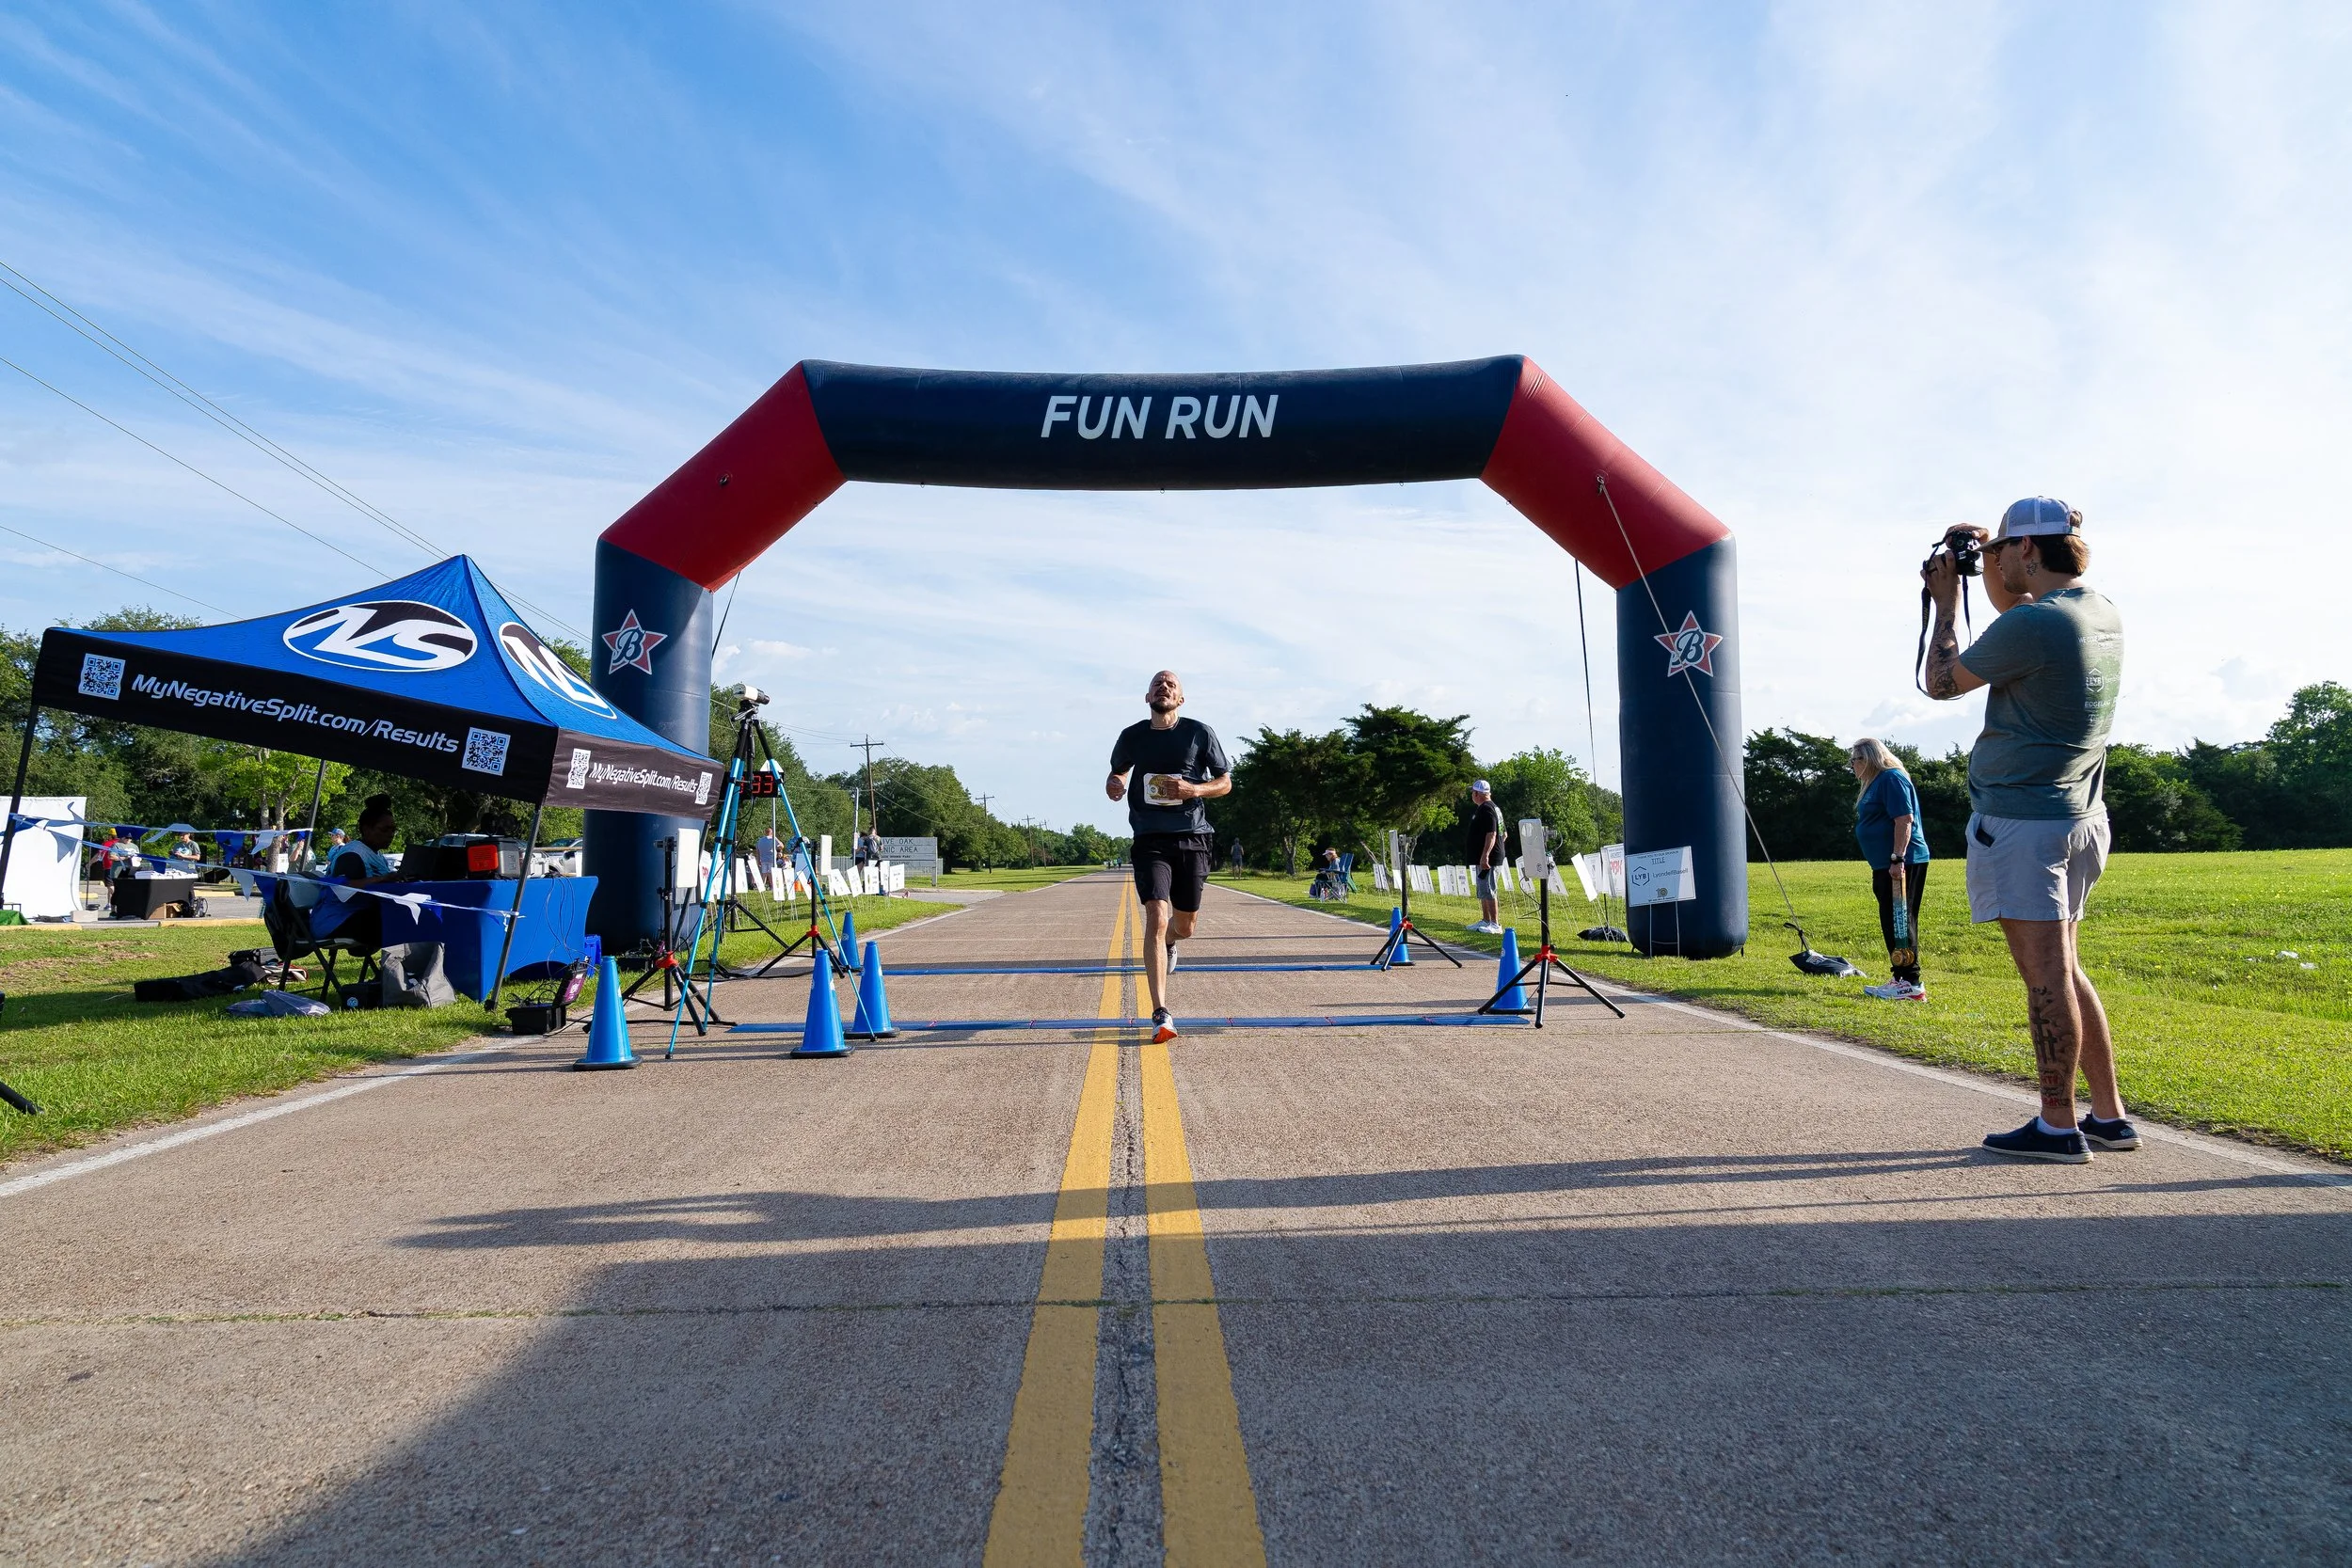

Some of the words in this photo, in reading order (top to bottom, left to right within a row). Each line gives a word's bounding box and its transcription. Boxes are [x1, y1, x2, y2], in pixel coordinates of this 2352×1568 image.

[1041, 395, 1152, 439] FUN
[1165, 394, 1279, 439] RUN
[131, 673, 460, 753] MyNegativeSplit.com/Results
[589, 763, 699, 793] MyNegativeSplit.com/Results
[1651, 857, 1665, 865] TITLE
